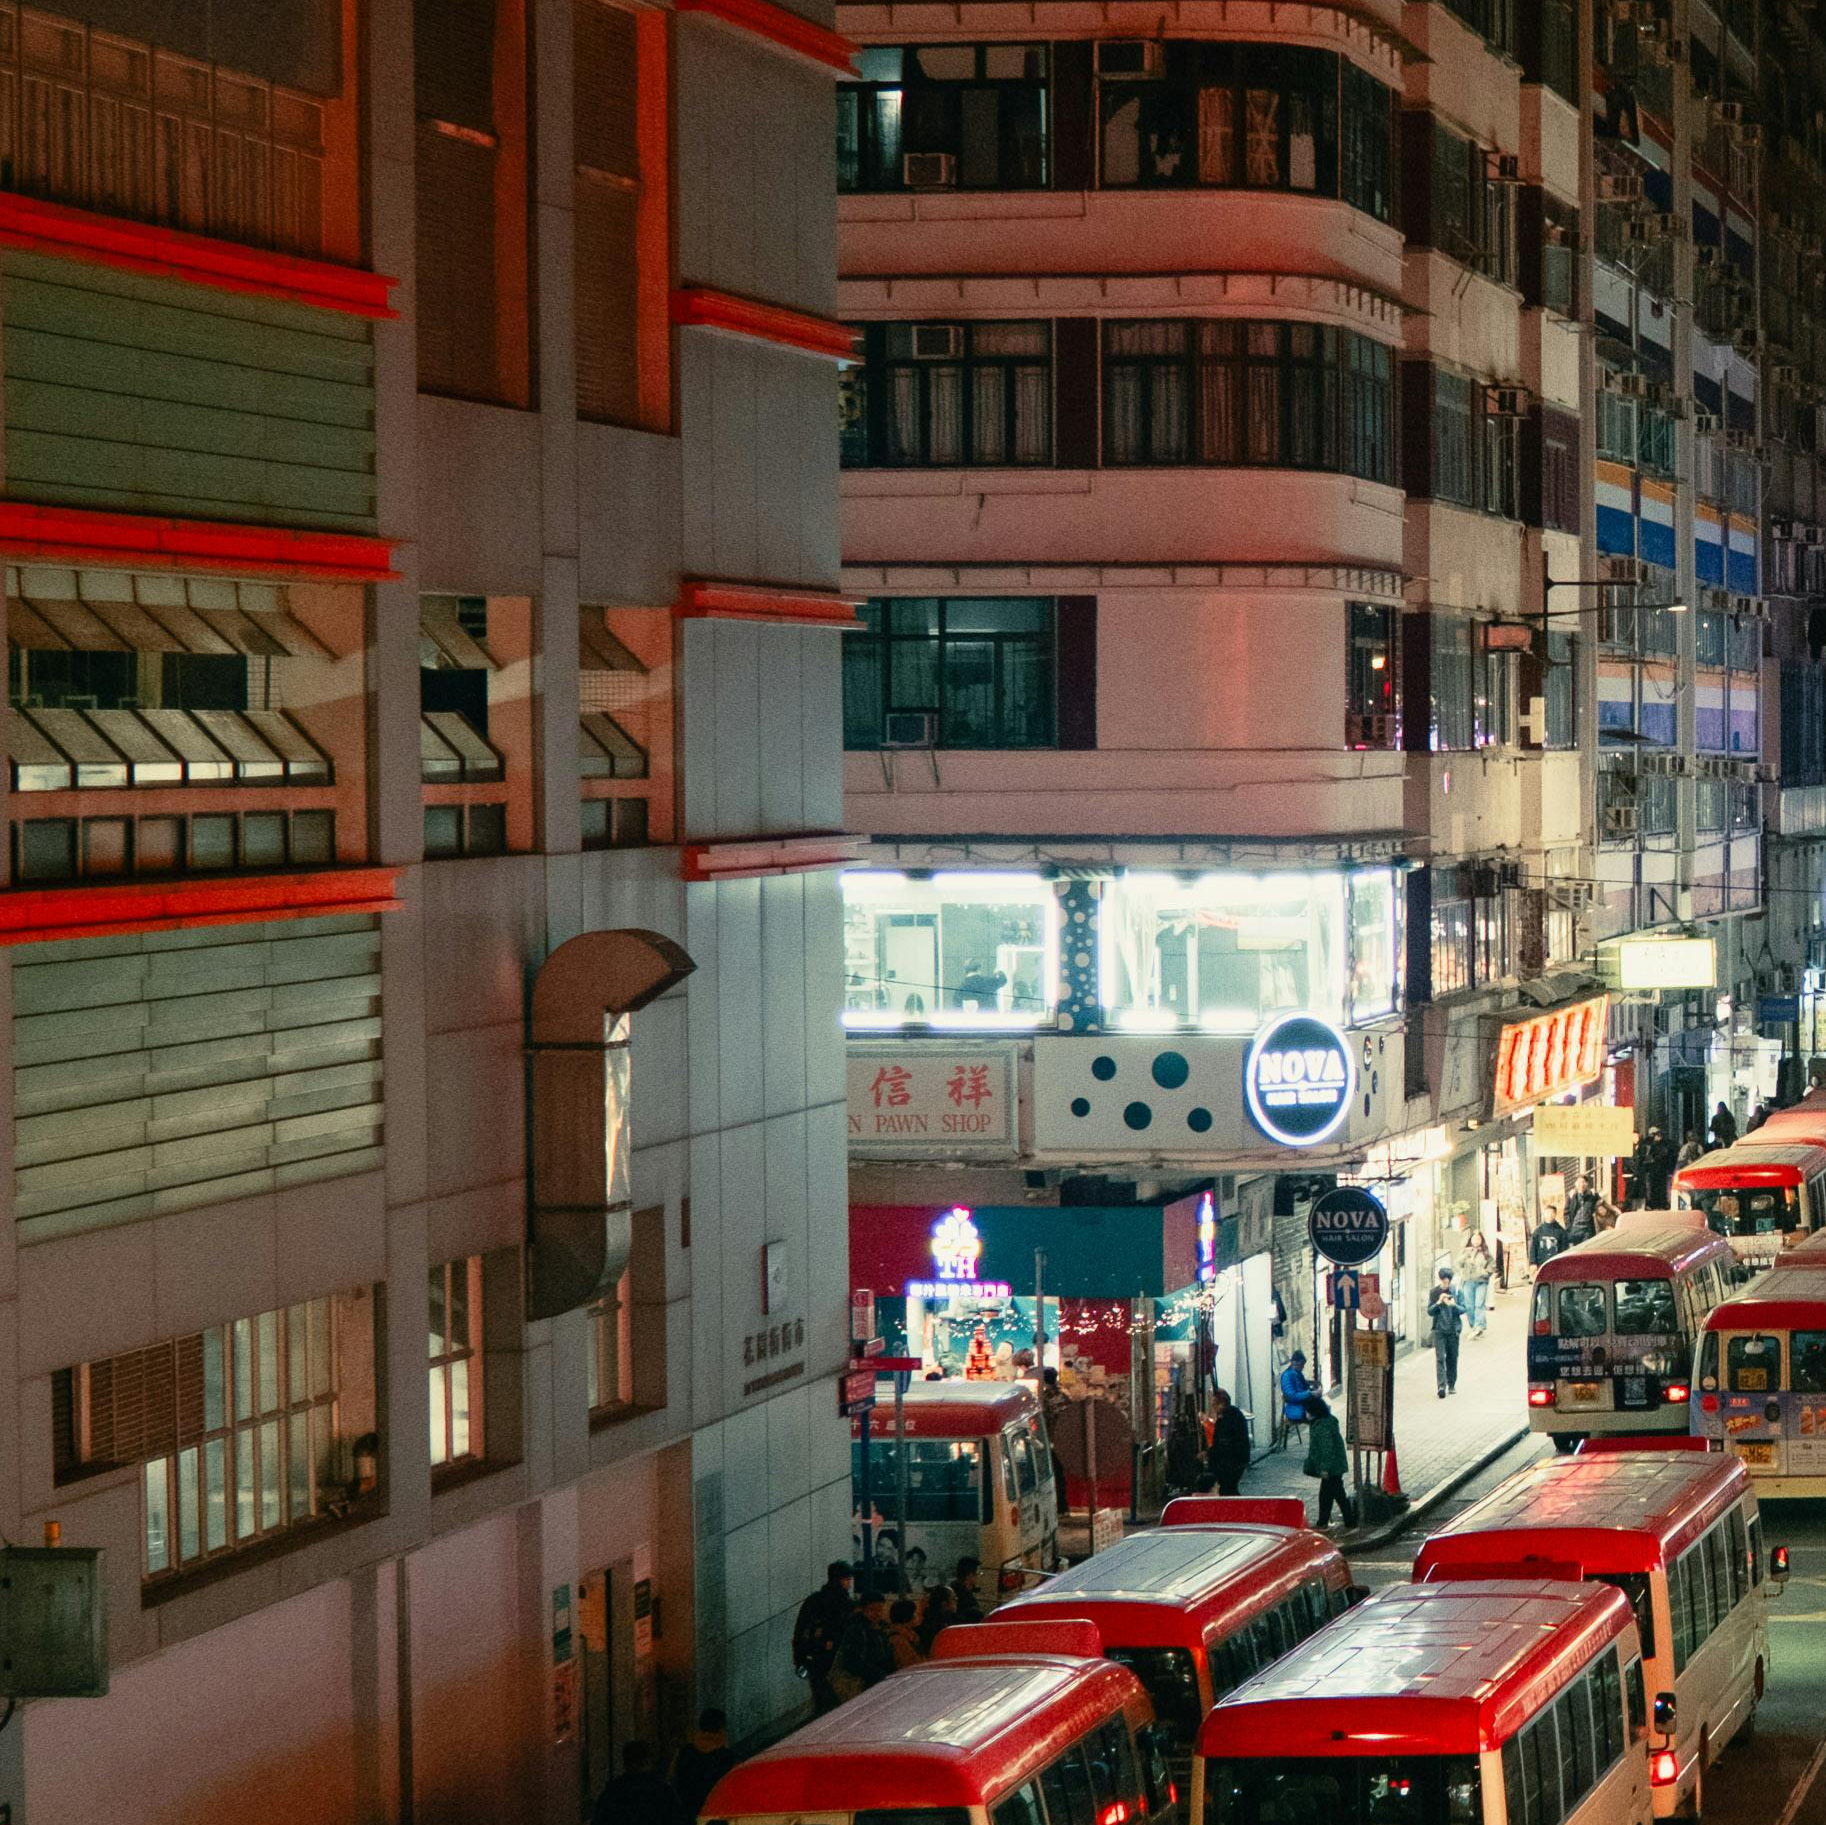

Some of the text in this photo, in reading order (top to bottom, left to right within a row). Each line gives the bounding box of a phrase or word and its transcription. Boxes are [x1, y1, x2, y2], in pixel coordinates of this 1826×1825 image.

[1258, 1049, 1345, 1084] NOVA
[875, 1114, 929, 1133] PAWN
[942, 1114, 991, 1133] SHOP
[1315, 1210, 1380, 1229] NOVA
